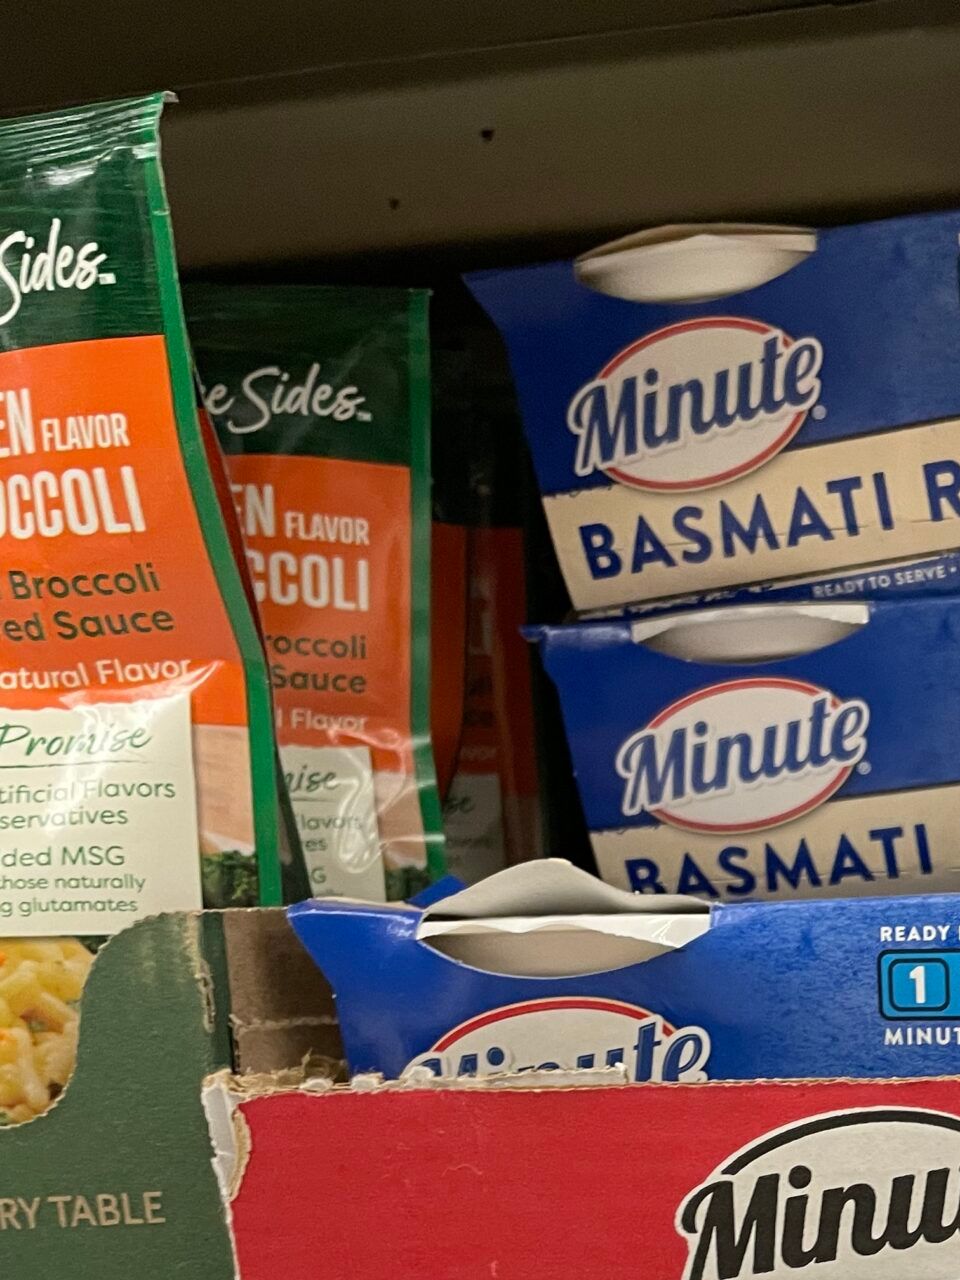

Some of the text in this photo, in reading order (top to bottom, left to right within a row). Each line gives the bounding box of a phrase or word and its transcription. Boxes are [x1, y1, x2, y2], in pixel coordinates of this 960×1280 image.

[572, 335, 820, 473] Minute
[41, 412, 130, 452] FLAVOR
[284, 511, 370, 546] FLAVOR
[578, 472, 894, 580] BASMATI
[9, 562, 160, 600] Broccoli
[812, 575, 865, 599] READY
[867, 573, 891, 590] TO
[895, 564, 947, 586] SERVE
[54, 609, 175, 640] Sauce
[97, 658, 191, 684] Flavor
[270, 667, 367, 694] Sauce
[291, 708, 368, 732] Flavor
[621, 698, 867, 813] Minute
[84, 778, 176, 799] Flavors
[1, 845, 126, 868] ded MSG
[626, 824, 932, 899] BASMATI
[55, 873, 146, 893] naturally
[19, 897, 139, 917] glutamates
[880, 926, 951, 943] READY
[908, 965, 927, 1005] 1
[0, 1191, 166, 1229] RY TABLE
